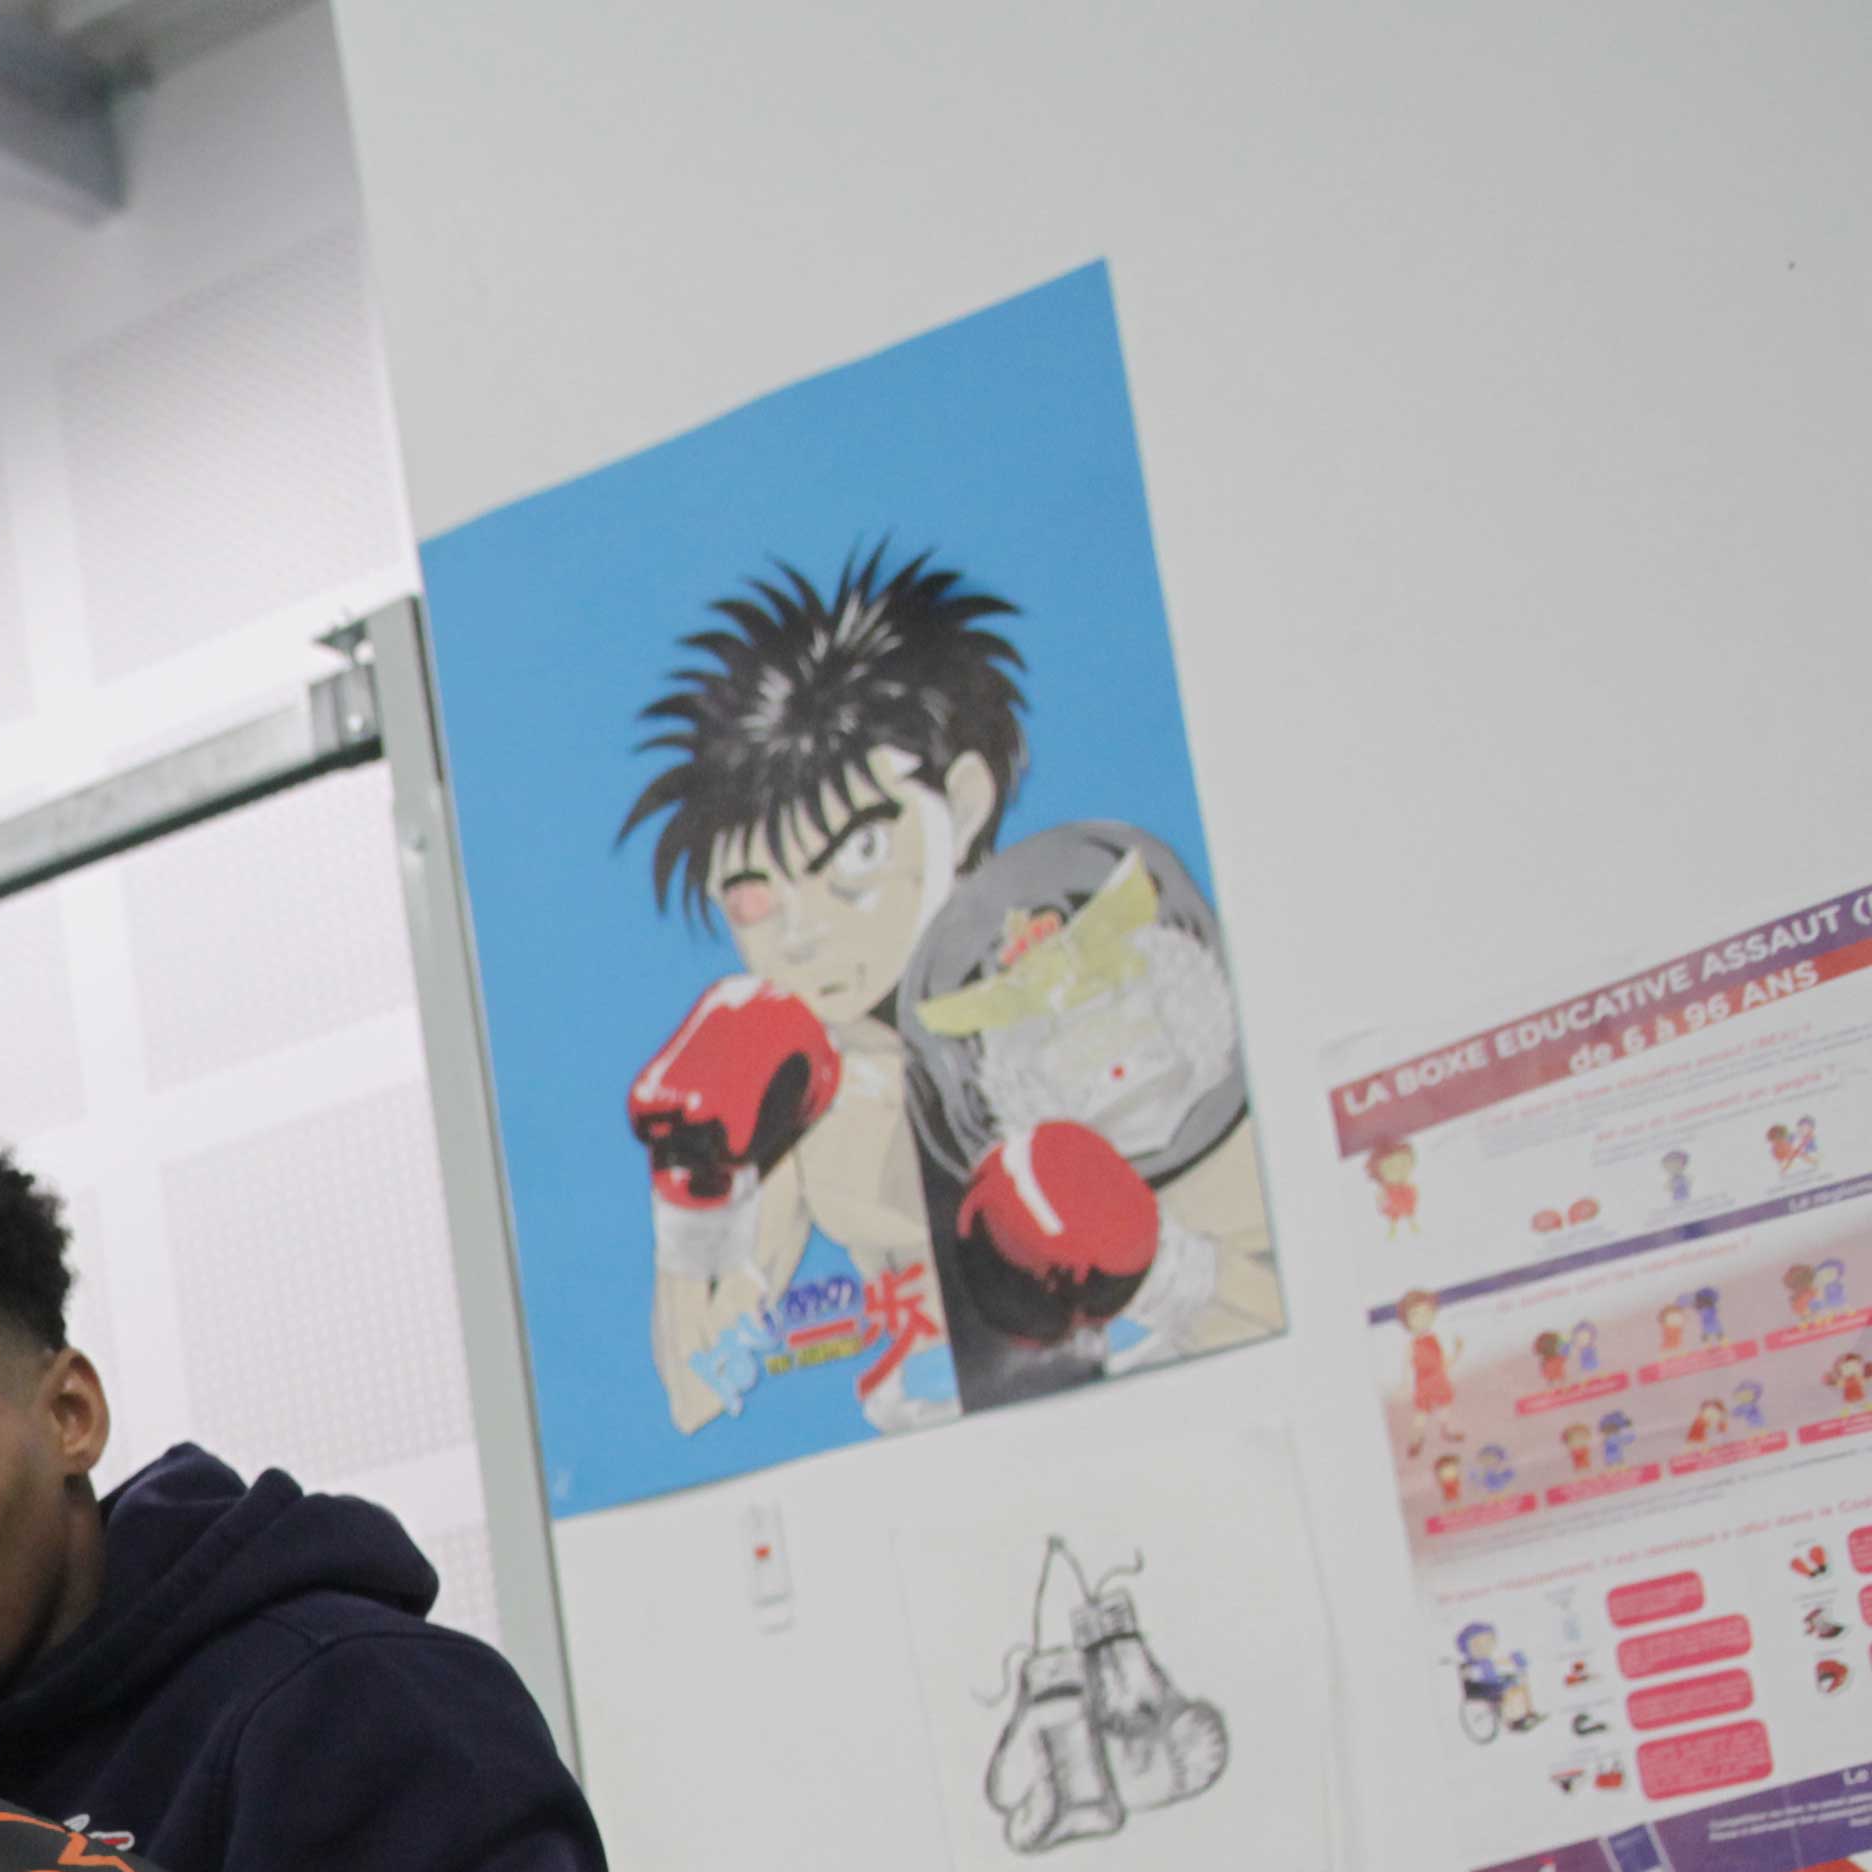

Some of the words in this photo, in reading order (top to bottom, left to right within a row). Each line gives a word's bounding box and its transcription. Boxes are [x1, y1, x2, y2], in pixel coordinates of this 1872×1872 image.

[1343, 1071, 1392, 1116] LA
[1394, 1035, 1491, 1097] BOXE
[1495, 963, 1695, 1059] EDUCATIVE
[1701, 904, 1842, 984] ASSAUT
[1568, 1039, 1614, 1075] de
[1742, 959, 1820, 1008] ANS
